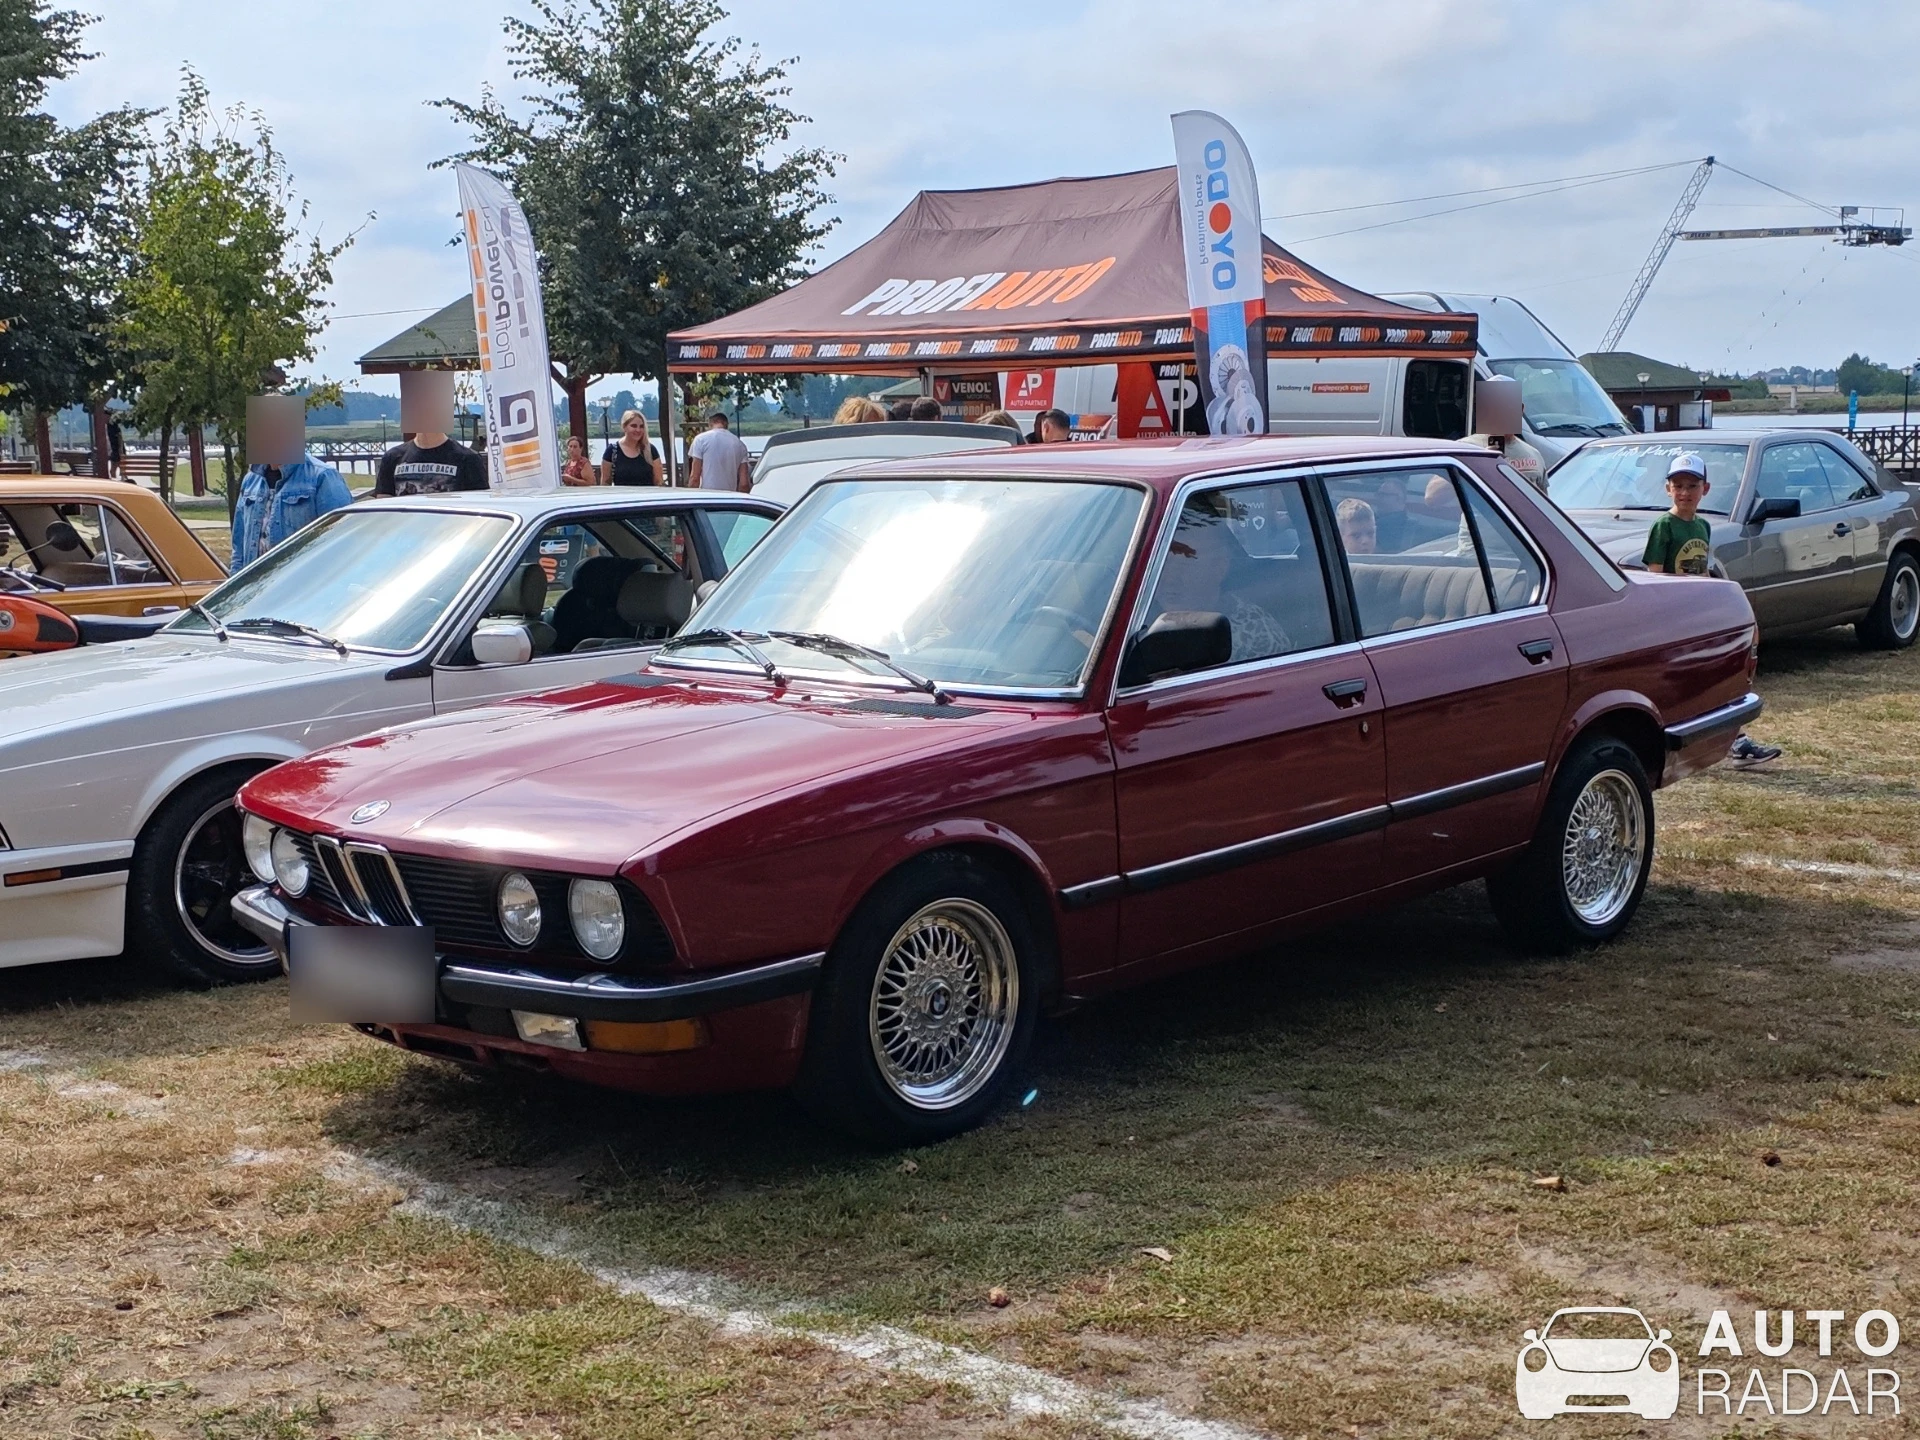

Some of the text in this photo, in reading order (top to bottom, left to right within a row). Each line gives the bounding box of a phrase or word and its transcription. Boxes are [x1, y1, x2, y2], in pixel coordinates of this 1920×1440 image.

[840, 257, 1116, 315] PROFIAUTO
[1089, 331, 1142, 348] PROFIAUTO
[1291, 327, 1333, 342] PROFIAUTO
[1339, 327, 1380, 342] PROFIAUTO
[1385, 328, 1425, 343] PROFIAUTO
[1428, 330, 1468, 343] PROFIAUTO
[864, 342, 911, 356] PROFIAUTO
[914, 341, 962, 355] PROFIAUTO
[969, 338, 1019, 353] PROFIAUTO
[1028, 335, 1080, 351] PROFIAUTO
[679, 345, 718, 359] PROFIAUTO
[726, 345, 766, 359] PROFIAUTO
[770, 344, 813, 358] PROFIAUTO
[816, 344, 861, 357] PROFIAUTO
[952, 382, 991, 393] VENOL
[397, 464, 454, 474] DON'T LOOK BACK
